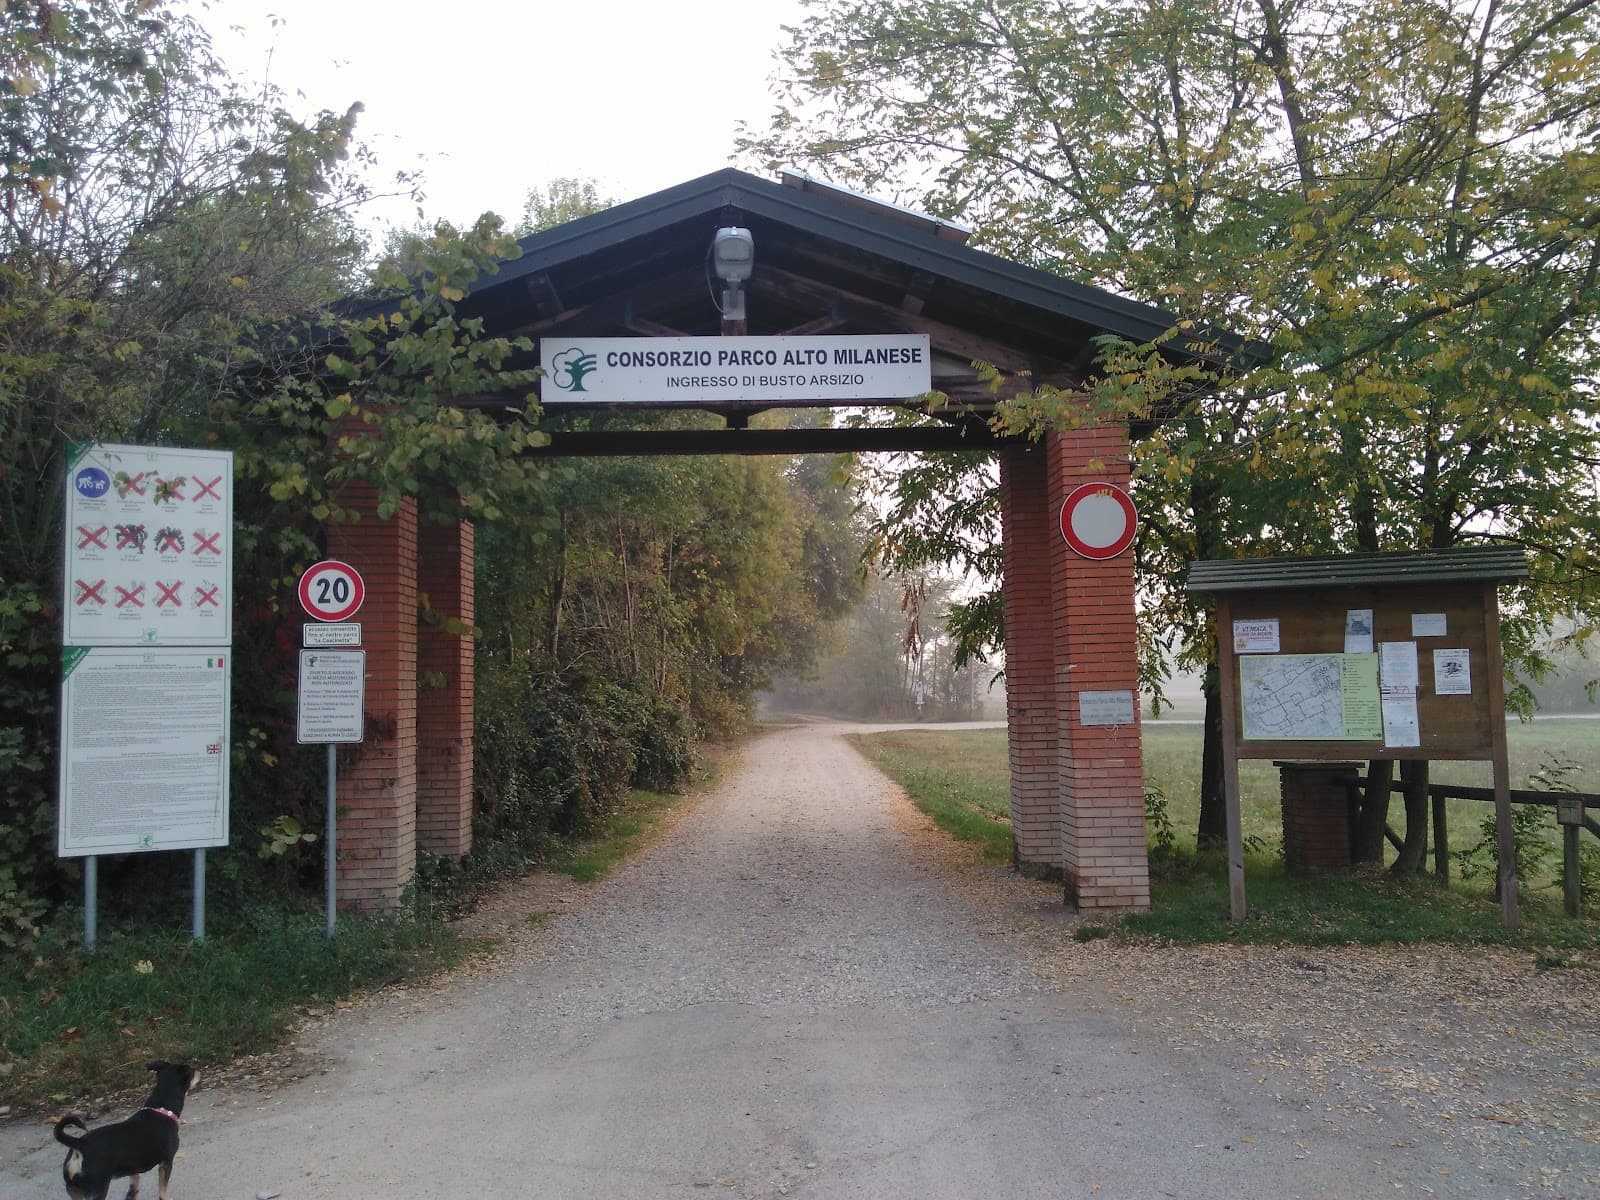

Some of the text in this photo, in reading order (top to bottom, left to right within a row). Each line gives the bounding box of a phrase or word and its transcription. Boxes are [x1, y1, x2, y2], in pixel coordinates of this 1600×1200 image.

[606, 348, 922, 368] CONSORZIO PARCO ALTO MILANESE
[666, 374, 865, 388] INGRESSO DI BUSTO ARSIZIO
[316, 577, 349, 604] 20
